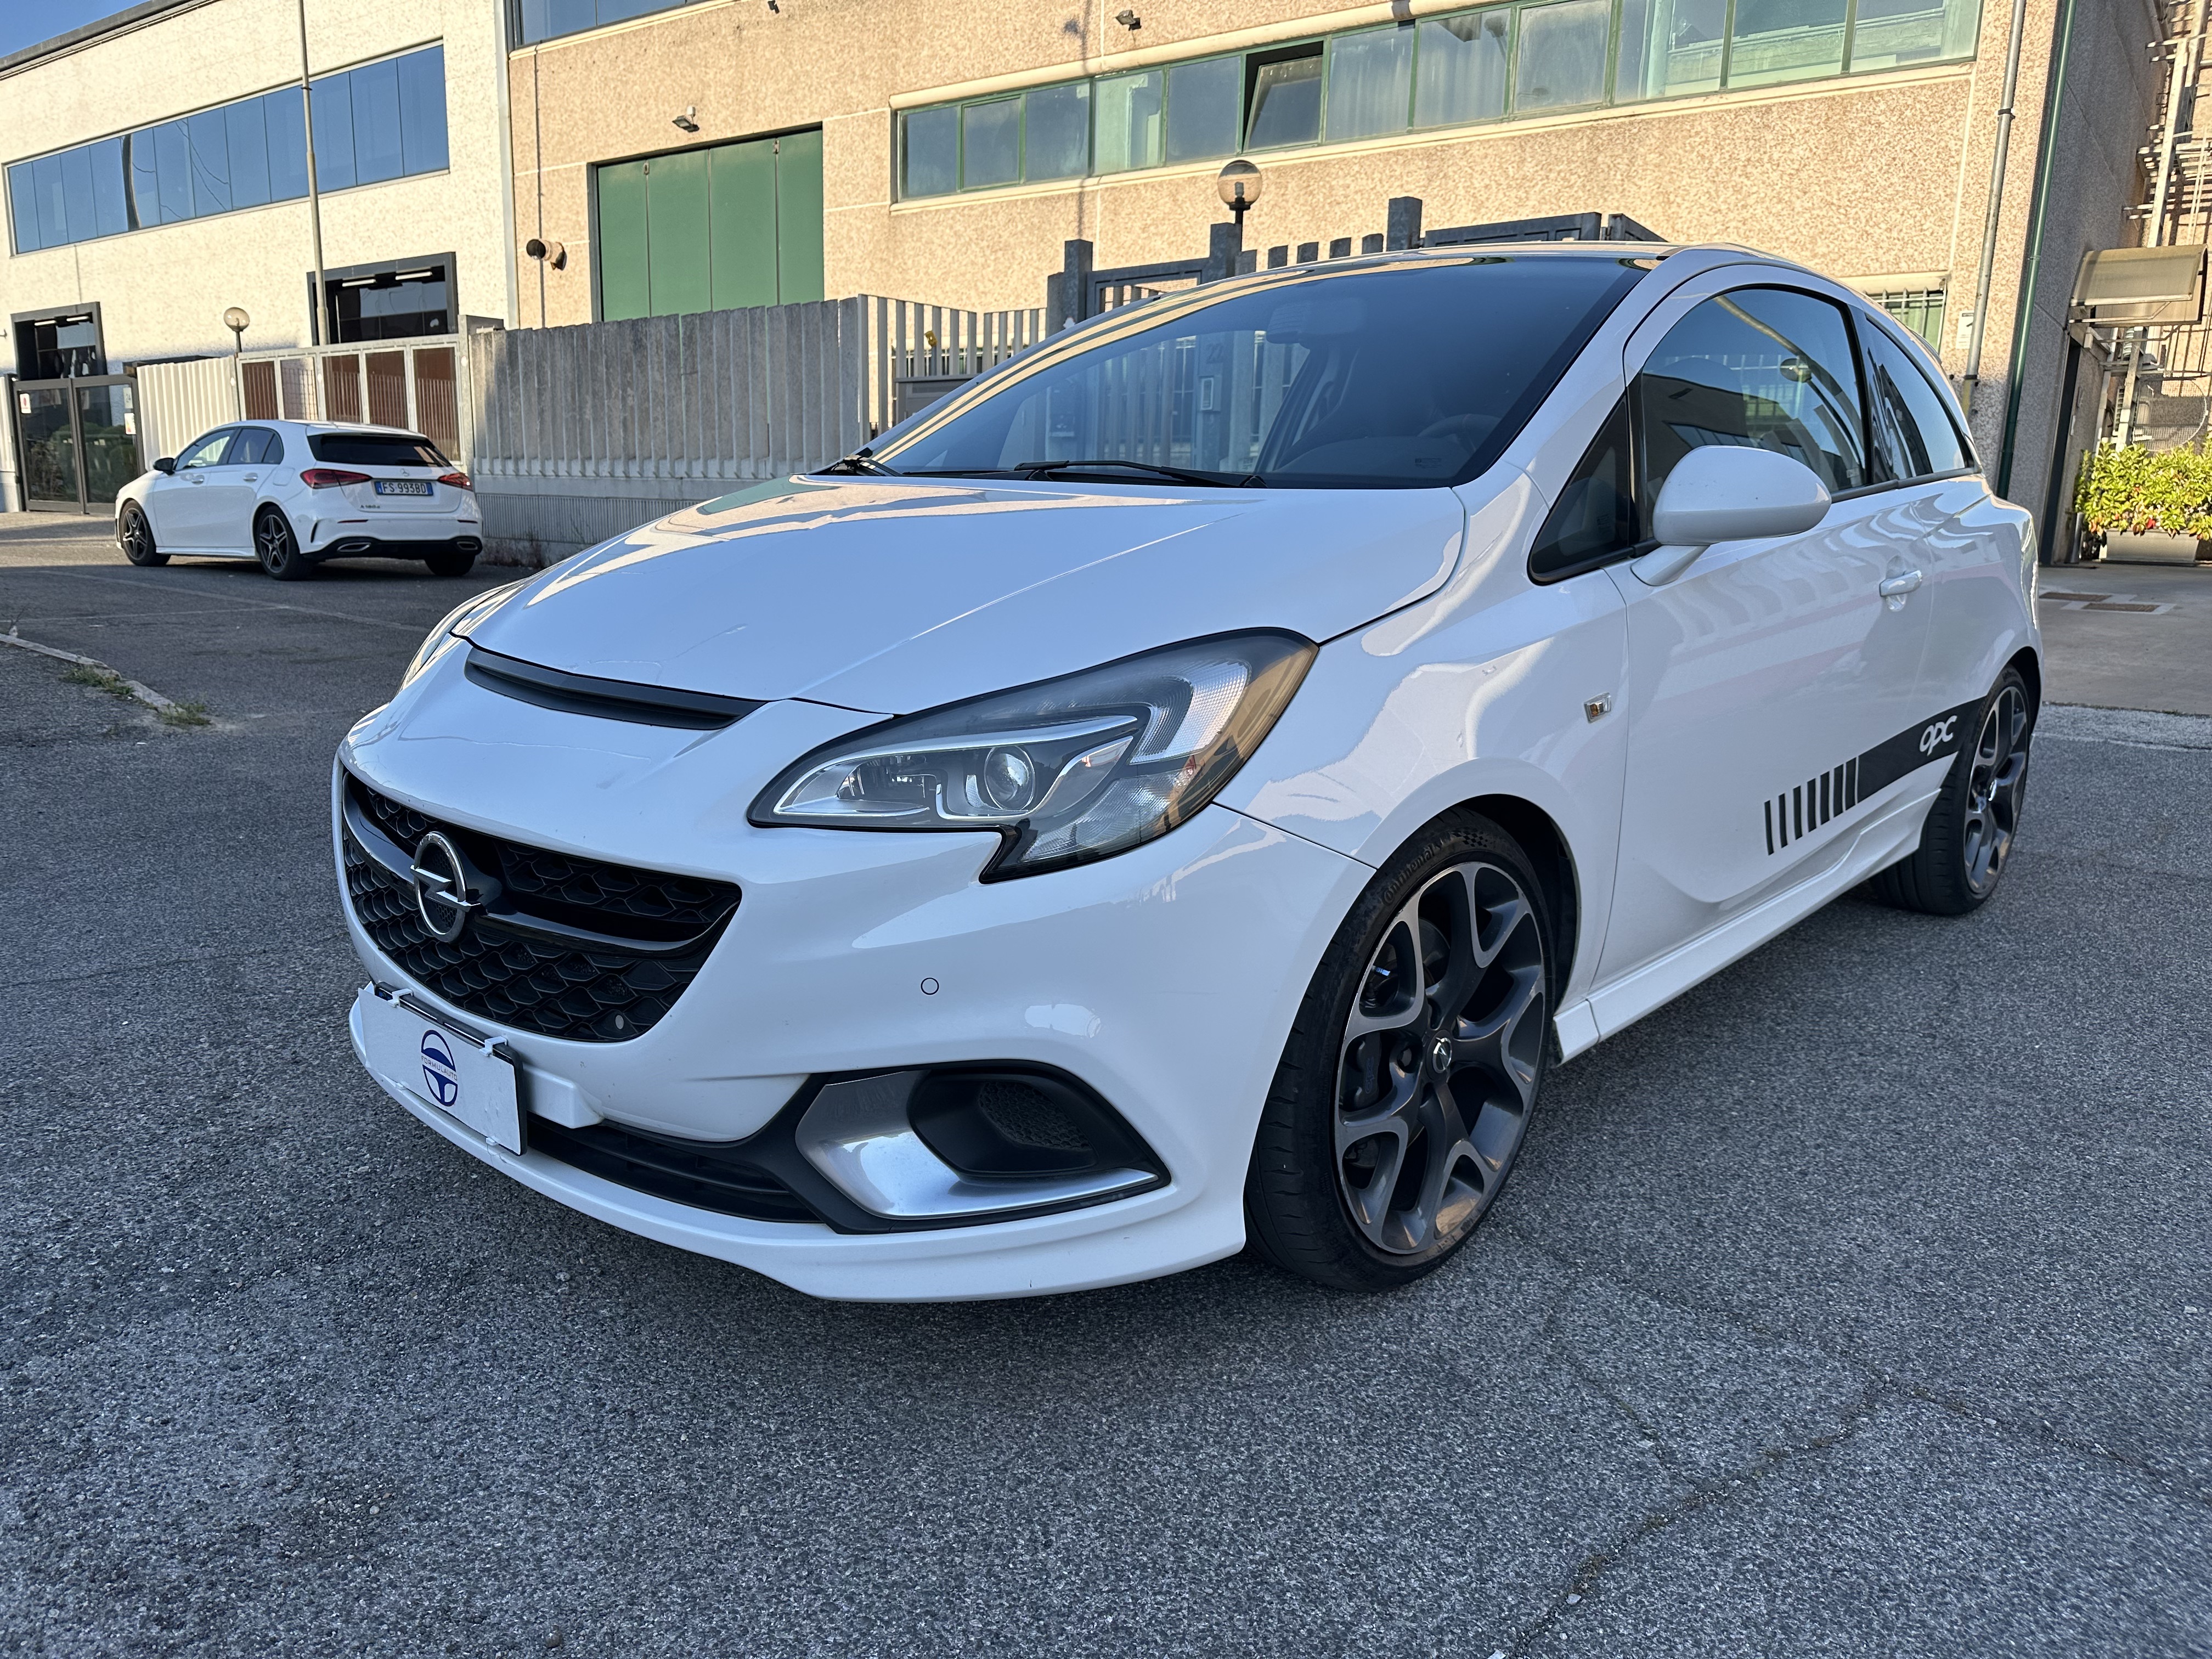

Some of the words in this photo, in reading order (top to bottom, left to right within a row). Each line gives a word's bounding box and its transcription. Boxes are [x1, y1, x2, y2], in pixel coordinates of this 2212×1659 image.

[382, 482, 395, 493] FS
[397, 482, 427, 493] 993BD
[421, 1055, 458, 1081] FORMULAUTO
